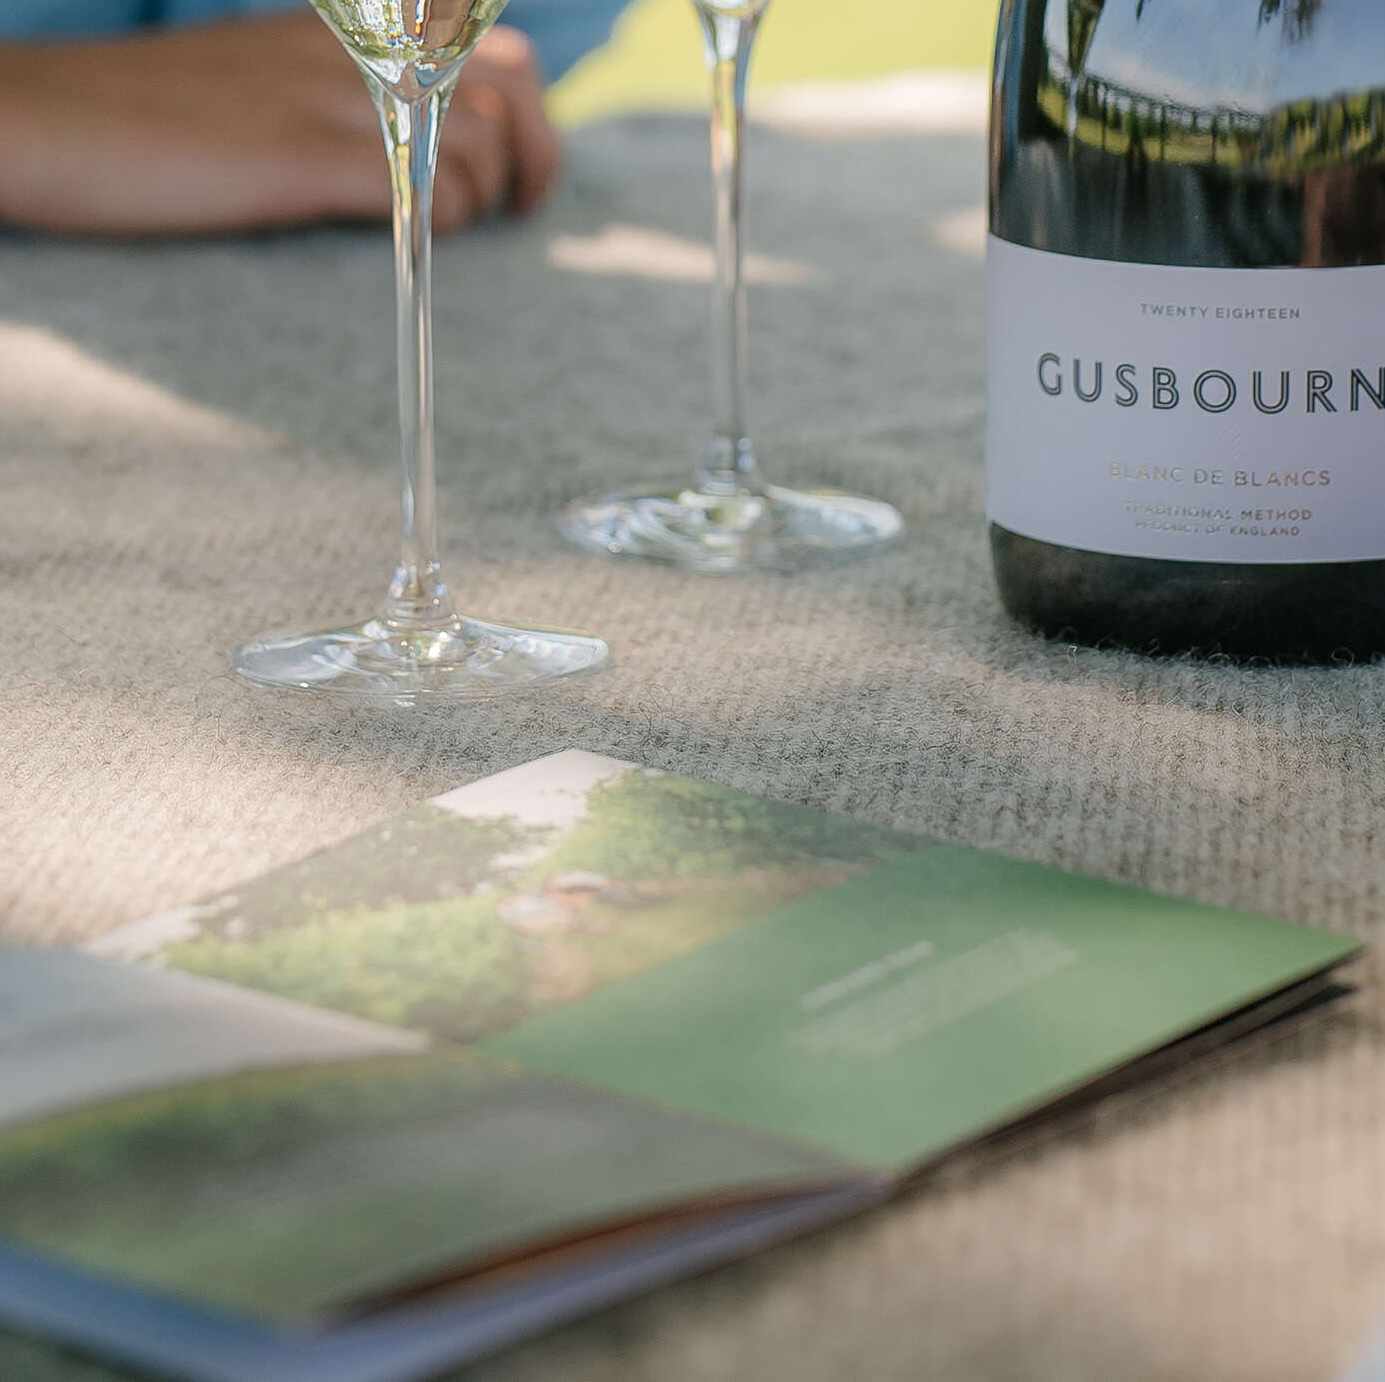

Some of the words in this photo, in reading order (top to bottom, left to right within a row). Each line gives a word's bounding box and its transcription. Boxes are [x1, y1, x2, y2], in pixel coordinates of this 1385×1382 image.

[1140, 302, 1208, 318] TWENTY
[1215, 306, 1301, 320] EIGHTEEN
[1109, 461, 1184, 483] BLANC
[1193, 468, 1224, 485] DE
[1234, 469, 1332, 487] BLANCS
[1240, 508, 1313, 522] METHOD
[1230, 525, 1301, 537] ENGLAND
